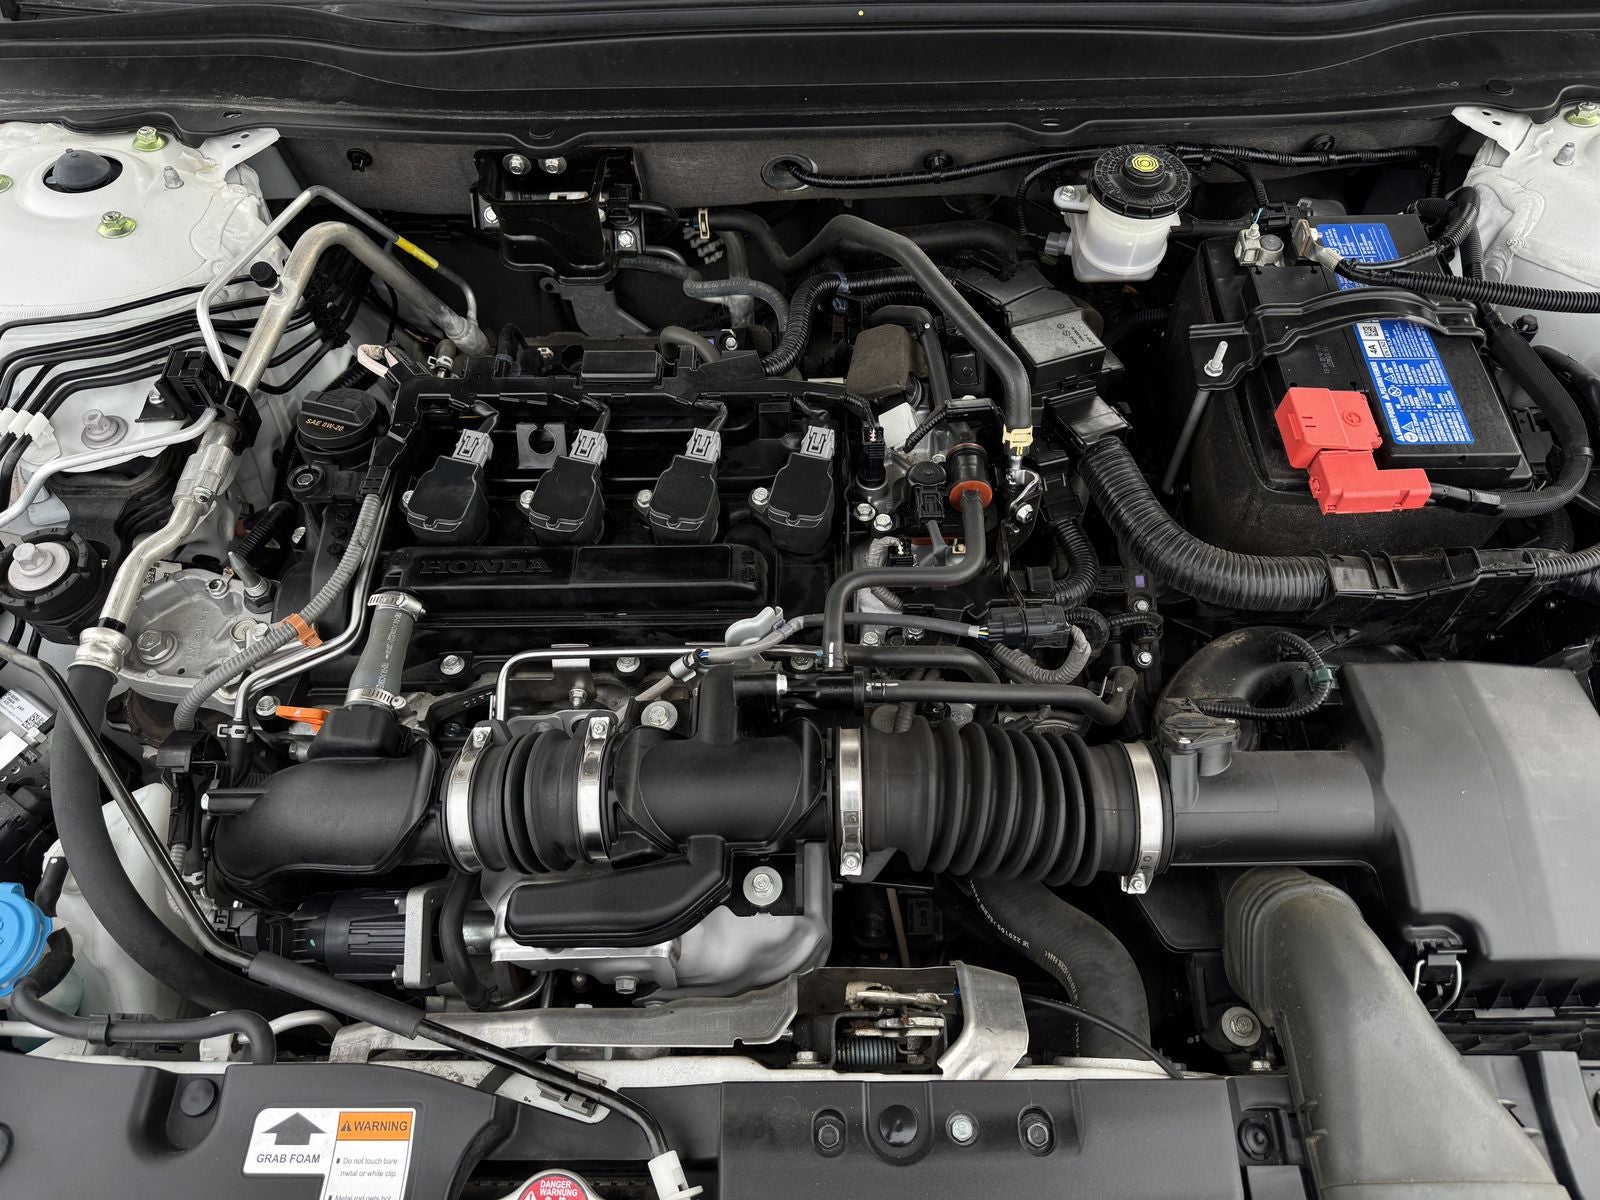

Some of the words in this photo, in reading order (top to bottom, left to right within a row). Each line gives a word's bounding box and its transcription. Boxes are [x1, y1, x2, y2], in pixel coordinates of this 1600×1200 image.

[1367, 344, 1379, 354] 4A
[306, 419, 322, 427] SAE
[322, 422, 344, 431] 0W-20
[419, 559, 552, 573] HONDA
[354, 1121, 408, 1132] WARNING
[256, 1154, 287, 1164] GRAB
[289, 1154, 321, 1164] FOAM
[385, 1170, 397, 1178] clip.
[540, 1180, 571, 1188] DANGER
[540, 1188, 577, 1196] WARNUNG
